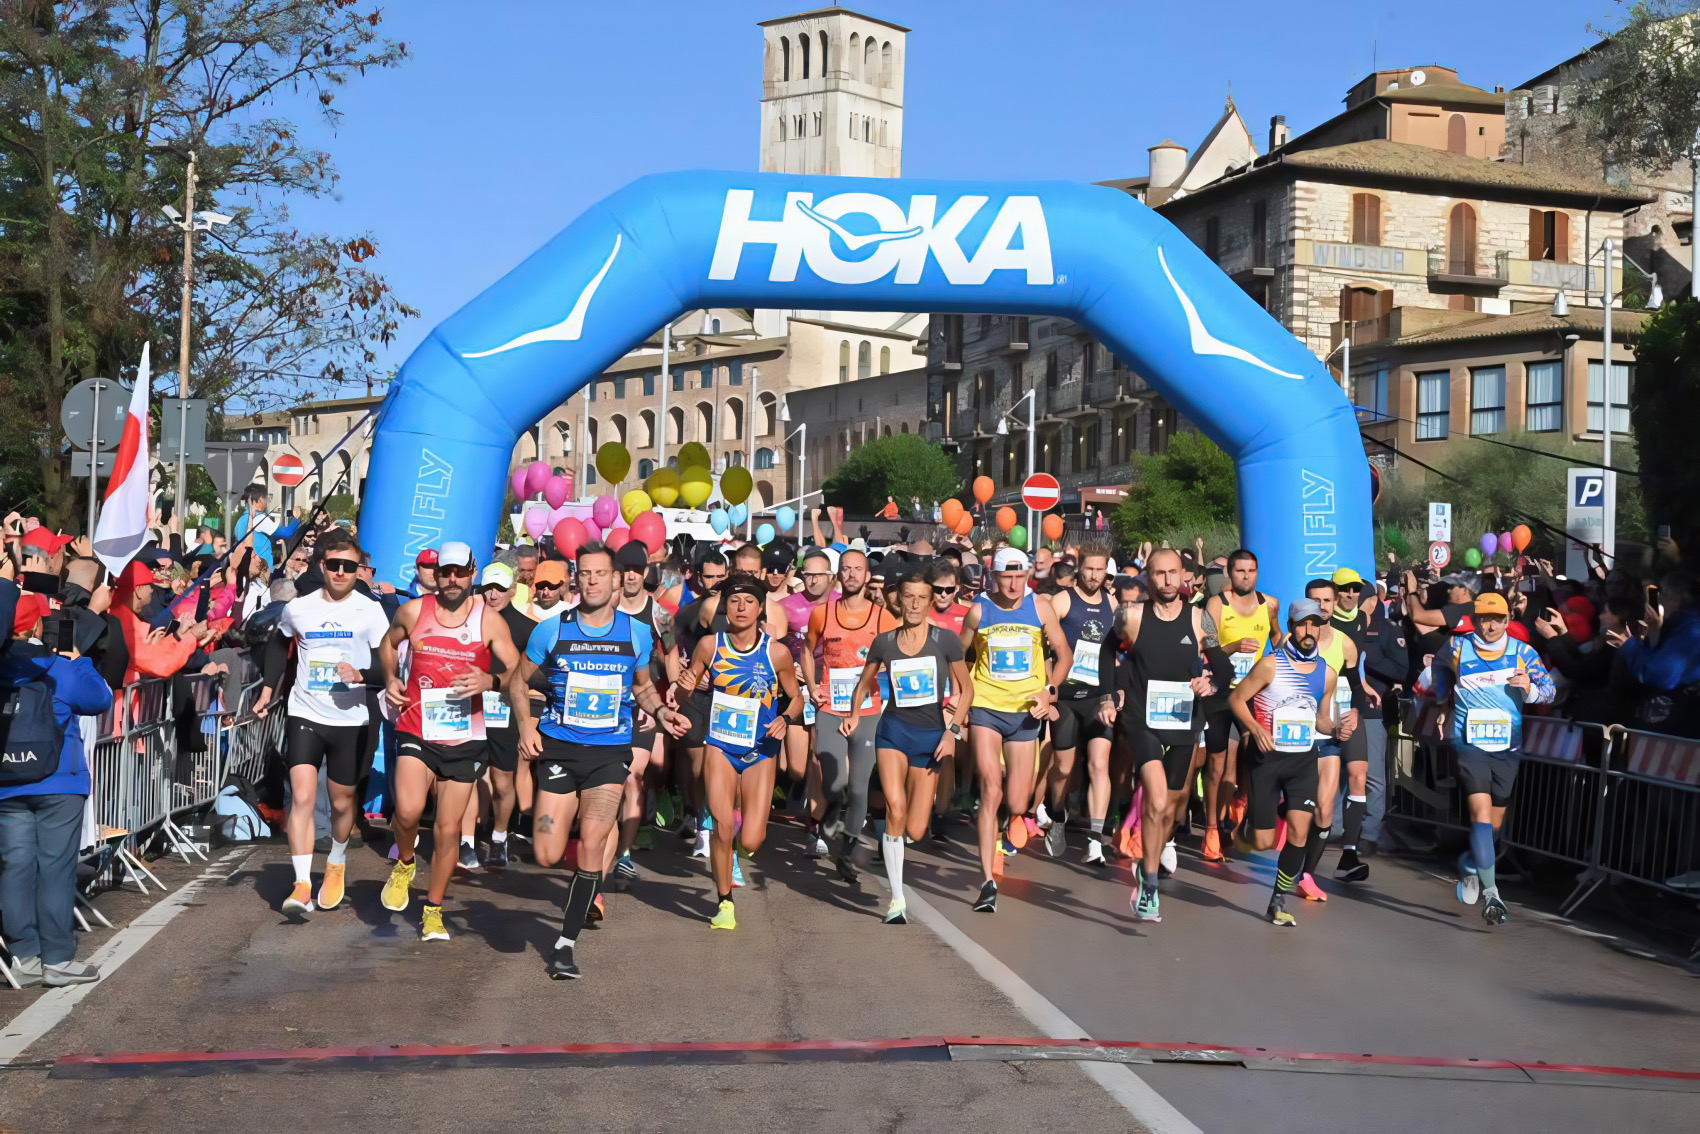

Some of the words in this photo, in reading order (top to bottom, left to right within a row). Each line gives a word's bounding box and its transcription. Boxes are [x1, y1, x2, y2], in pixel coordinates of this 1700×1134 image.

[707, 188, 1054, 286] HOKA
[410, 447, 454, 520] FLY
[1301, 467, 1337, 536] FLY
[1579, 478, 1603, 505] P
[587, 694, 599, 711] 2
